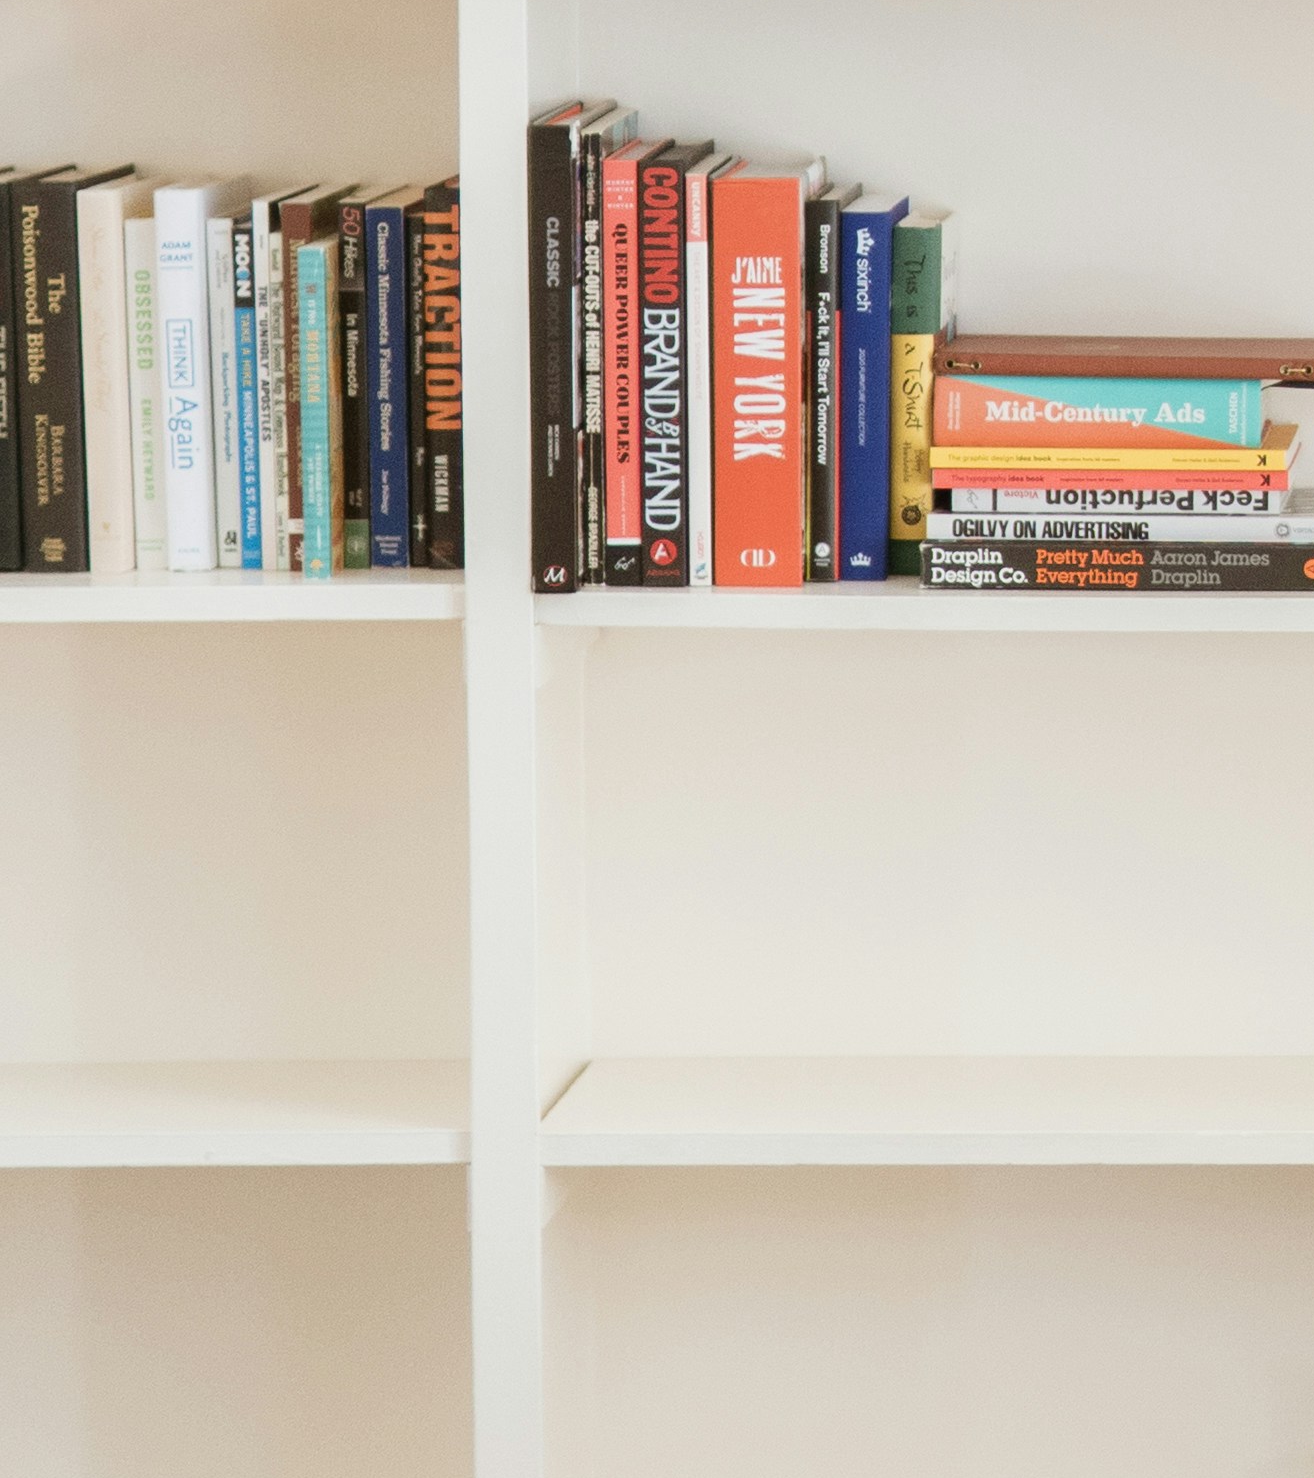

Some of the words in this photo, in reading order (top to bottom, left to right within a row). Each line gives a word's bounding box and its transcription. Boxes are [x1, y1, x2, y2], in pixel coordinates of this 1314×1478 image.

[341, 205, 361, 236] 50
[584, 219, 600, 243] the
[642, 166, 680, 304] CONTINO
[690, 181, 702, 239] UNCANNY
[21, 204, 45, 327] Poisonwood
[159, 253, 194, 263] GRANT
[160, 240, 193, 250] ADAM
[233, 233, 253, 298] MOON
[343, 236, 358, 279] Hikes
[376, 222, 392, 272] Classic
[546, 216, 561, 289] CLASSIC
[612, 222, 630, 290] QUEER
[818, 223, 832, 274] Bronson
[46, 272, 68, 315] The
[584, 245, 600, 311] CUT-OUTS
[731, 255, 784, 286] J'AIME
[855, 257, 873, 312] sixinch
[903, 255, 928, 297] This
[134, 269, 154, 371] OBSESSED
[258, 285, 269, 308] THE
[377, 273, 392, 345] Minnesota
[423, 203, 462, 432] TRACTION
[586, 313, 600, 329] of
[906, 305, 920, 319] is
[614, 294, 630, 369] POWER
[732, 286, 787, 362] NEW
[25, 331, 46, 385] Bible
[172, 324, 188, 383] THINK
[346, 329, 360, 398] Minnesota
[377, 347, 393, 400] Fishing
[585, 330, 601, 372] HENRI
[644, 307, 681, 419] BRAND
[817, 357, 830, 393] Start
[904, 343, 917, 357] a
[259, 380, 272, 442] APOSTLES
[380, 402, 393, 452] Stories
[585, 374, 602, 434] MATISSE
[616, 373, 631, 465] COUPLES
[732, 373, 787, 462] YORK
[984, 400, 1148, 427] Mid-Century
[1153, 401, 1206, 424] Ads
[1228, 391, 1240, 435] TASCHEN
[167, 396, 201, 471] Again
[243, 390, 256, 474] MINNEAPOLIS
[817, 395, 831, 465] Tomorrow
[433, 453, 451, 513] WICKMAN
[948, 454, 962, 462] The
[963, 454, 990, 464] graphic
[990, 454, 1015, 464] design
[1015, 454, 1032, 462] idea
[1033, 454, 1052, 463] book
[951, 473, 966, 482] The
[966, 473, 1007, 484] typography
[1007, 473, 1024, 482] idea
[1025, 473, 1045, 483] book
[644, 437, 681, 532] HAND
[1003, 489, 1039, 500] Victore
[1045, 488, 1195, 512] Perfuction
[1201, 489, 1269, 512] Feck
[246, 507, 258, 540] PAUL
[952, 518, 1009, 539] OGILVY
[1012, 519, 1037, 539] ON
[1041, 520, 1150, 541] ADVERTISING
[930, 547, 1004, 569] Draplin
[930, 567, 997, 589] Design
[998, 567, 1029, 584] Co.
[1035, 548, 1089, 568] Pretty
[1091, 548, 1144, 566] Much
[1035, 567, 1139, 588] Everything
[1150, 549, 1208, 566] Aaron
[1210, 550, 1271, 566] James
[1150, 568, 1222, 588] Draplin
